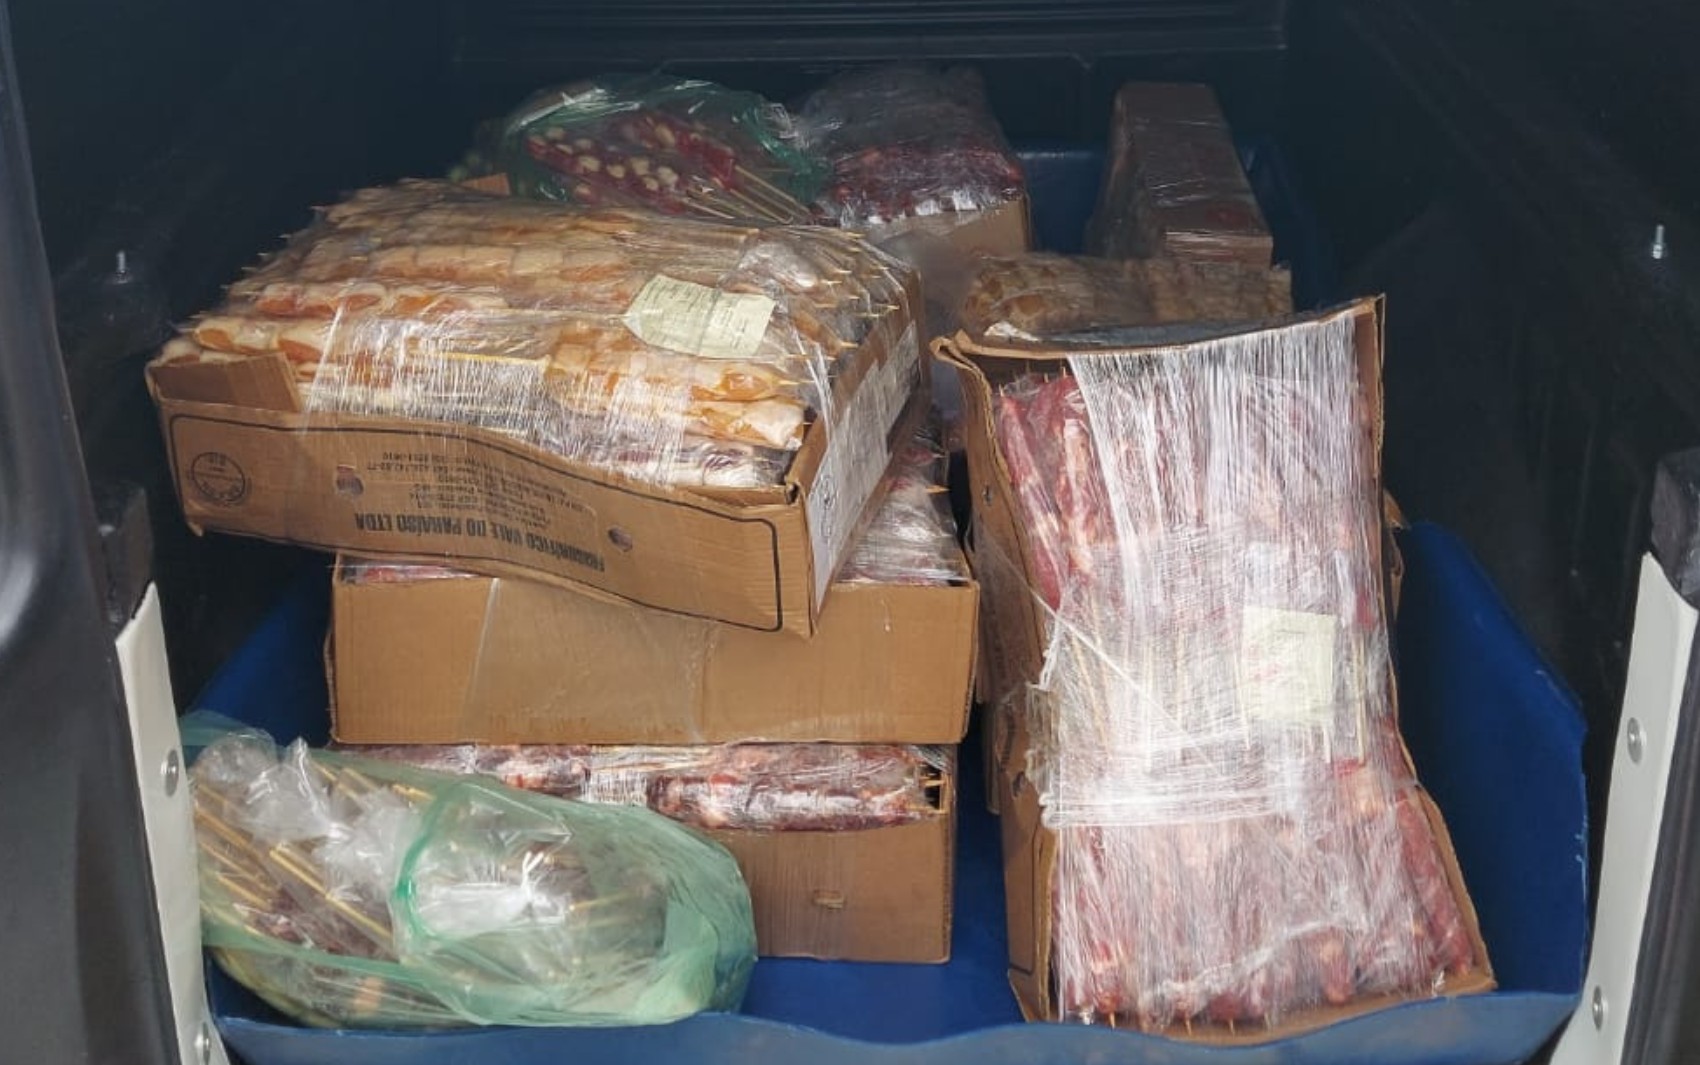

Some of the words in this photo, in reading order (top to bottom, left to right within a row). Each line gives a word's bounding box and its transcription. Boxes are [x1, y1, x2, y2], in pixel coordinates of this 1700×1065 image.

[354, 512, 393, 532] LTDA
[396, 514, 463, 537] PARAÍSO
[466, 515, 487, 537] DO
[491, 519, 524, 546] VALE
